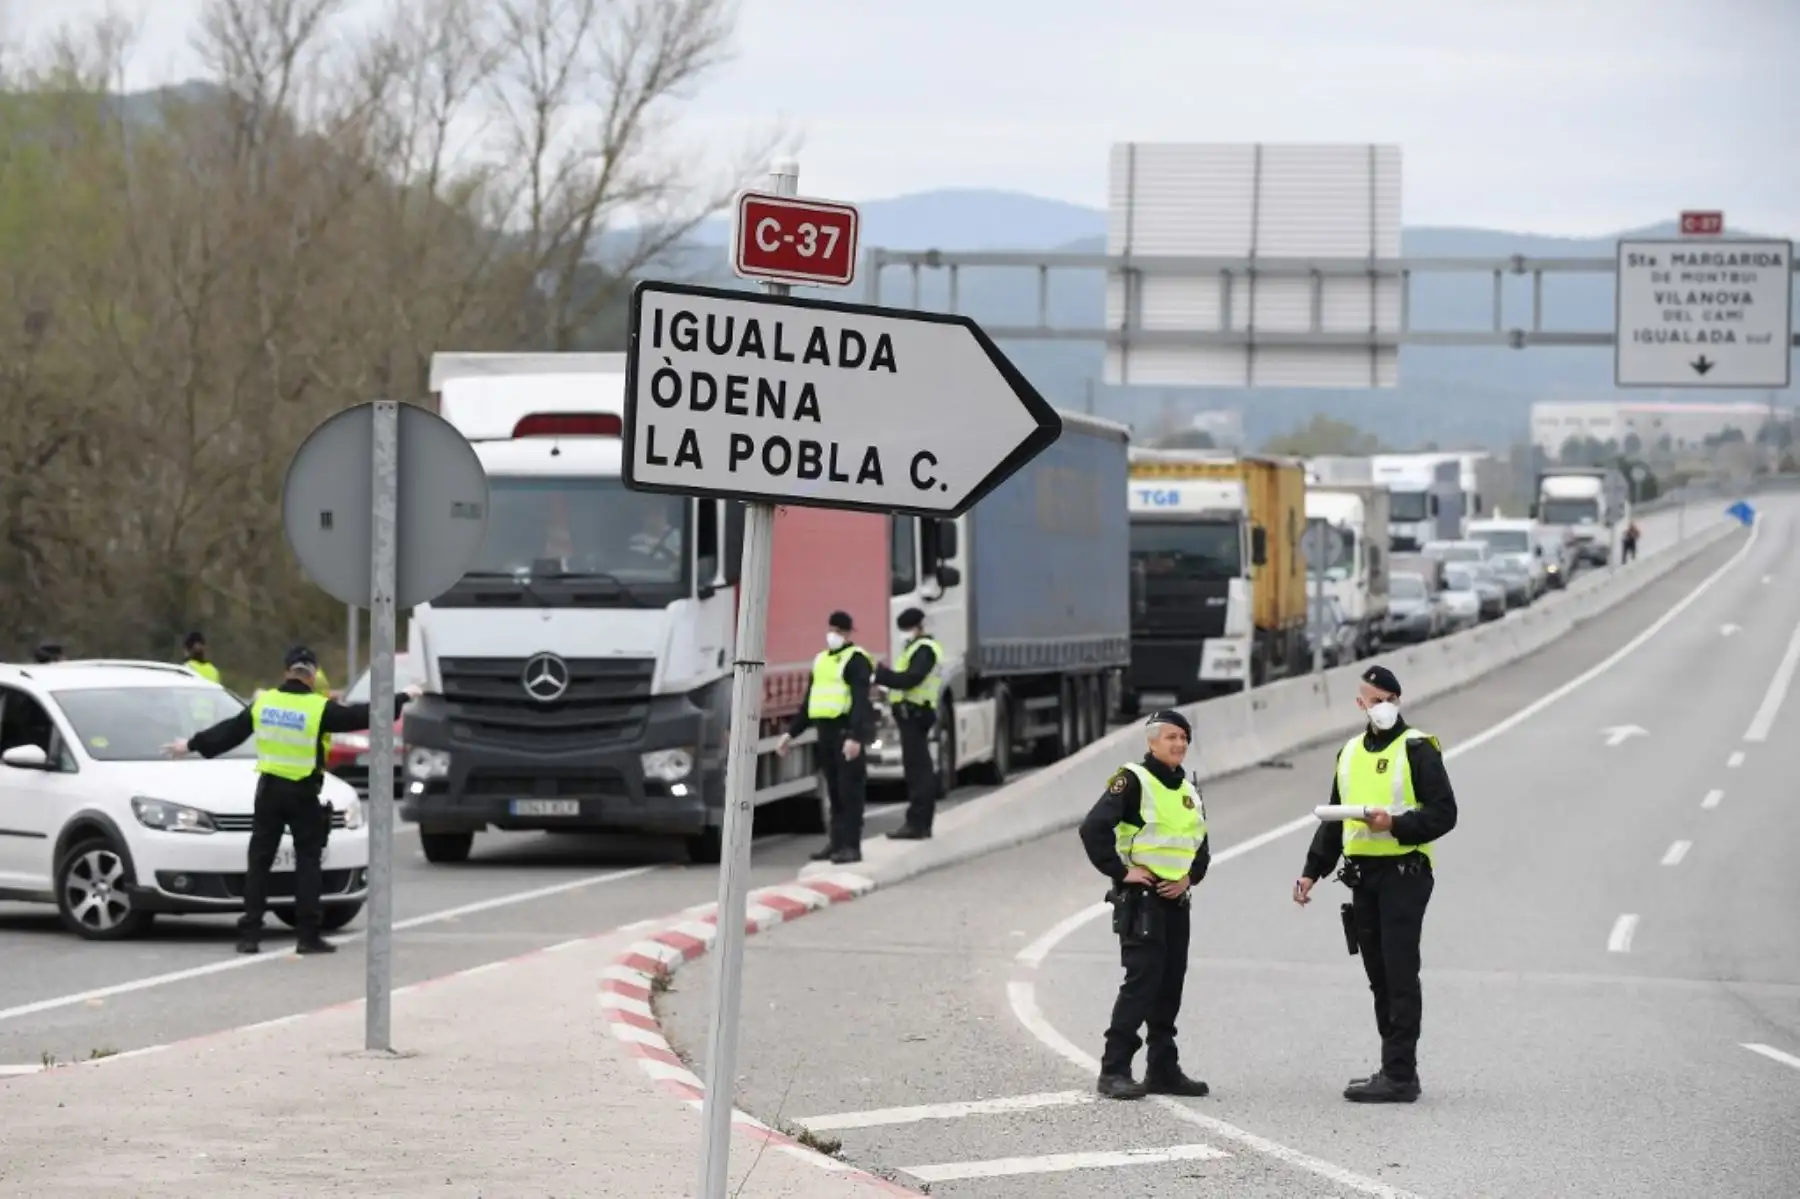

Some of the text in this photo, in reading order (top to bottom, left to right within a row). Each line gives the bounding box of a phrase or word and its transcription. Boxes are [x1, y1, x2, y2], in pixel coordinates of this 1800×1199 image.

[754, 217, 842, 260] C-37
[1670, 252, 1783, 267] MARGARIDA
[1651, 271, 1672, 283] DE
[1654, 291, 1754, 305] VILANOVA
[1663, 309, 1693, 322] DEL
[653, 308, 898, 374] IGUALADA
[1633, 329, 1737, 344] IGUALADA
[651, 356, 822, 424] ÒDENA
[645, 424, 948, 493] LA POBLA C.
